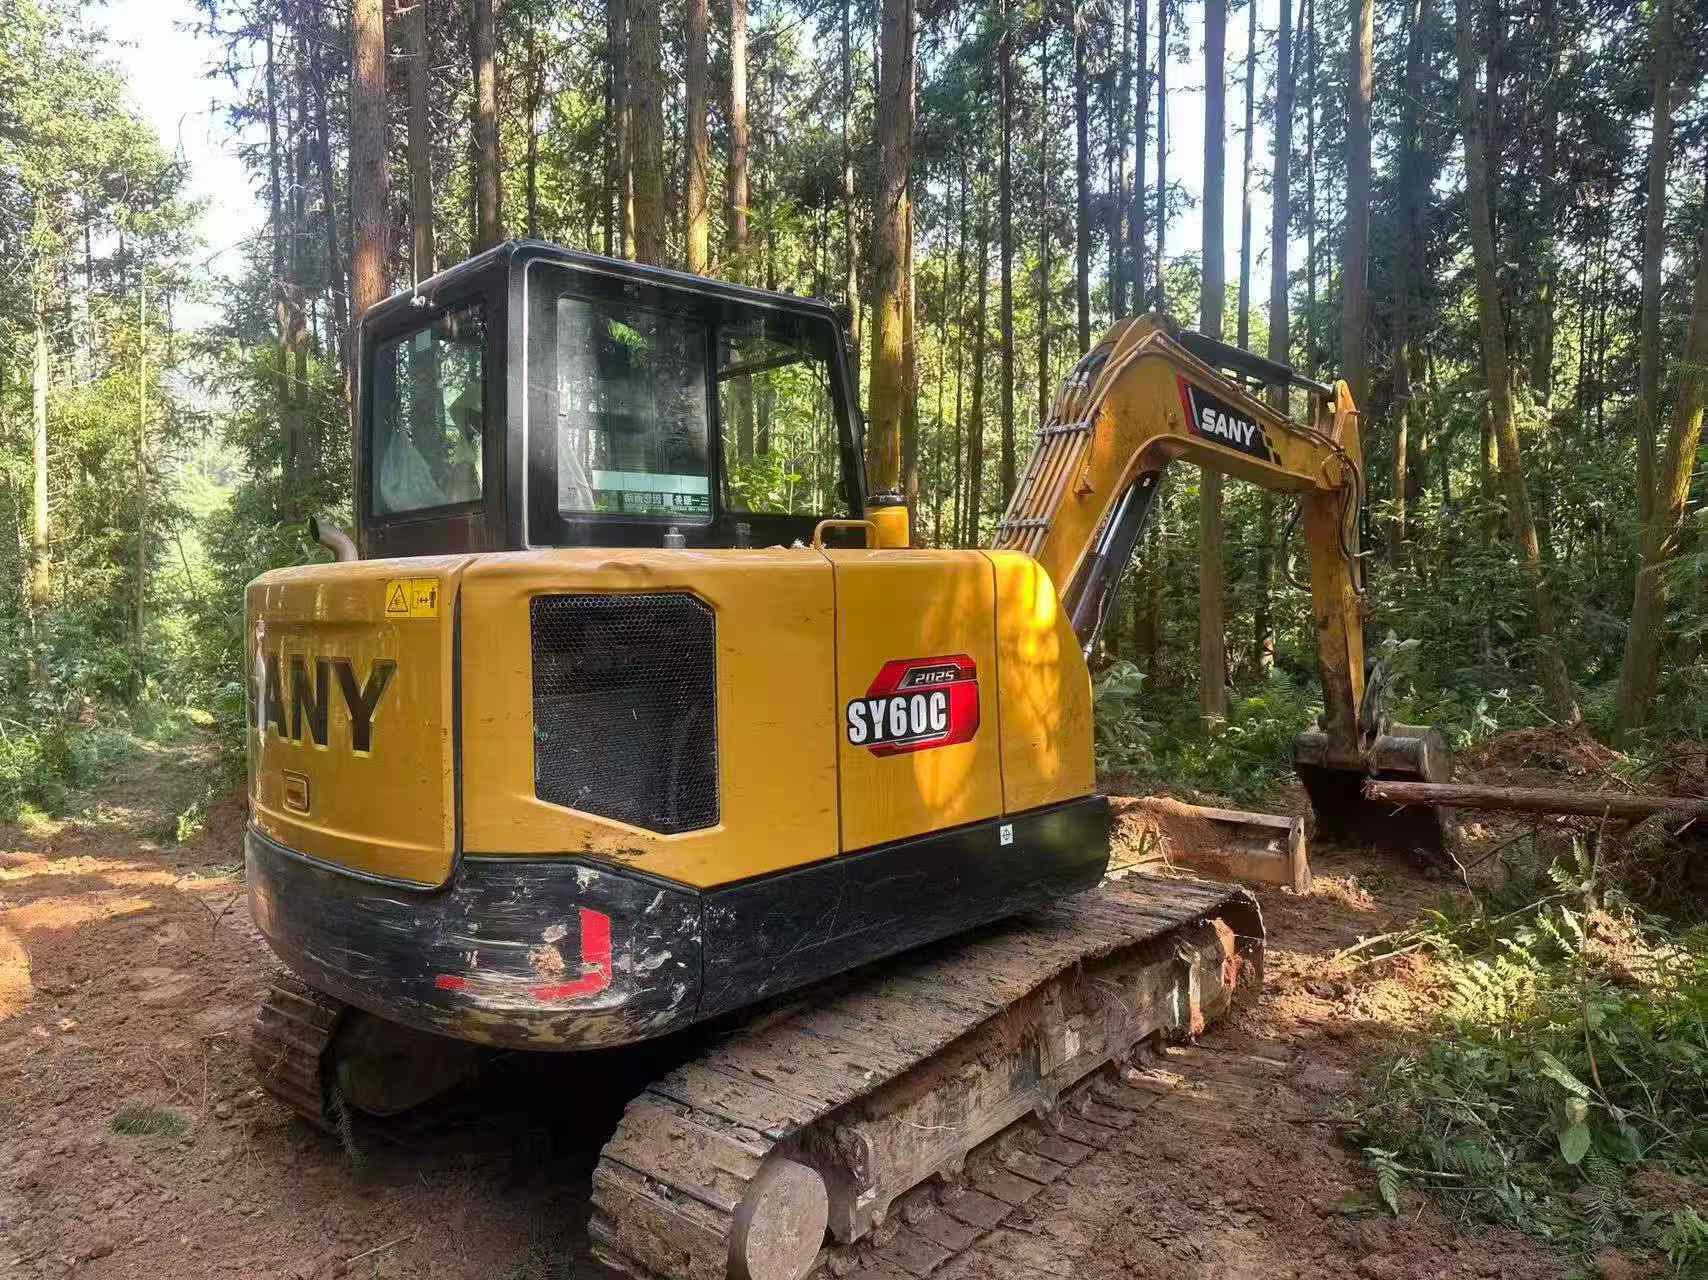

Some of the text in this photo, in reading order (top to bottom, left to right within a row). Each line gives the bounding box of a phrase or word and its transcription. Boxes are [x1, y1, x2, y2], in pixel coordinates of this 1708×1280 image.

[1201, 407, 1255, 447] SANY
[248, 655, 397, 754] ANY
[848, 692, 947, 743] SY60C
